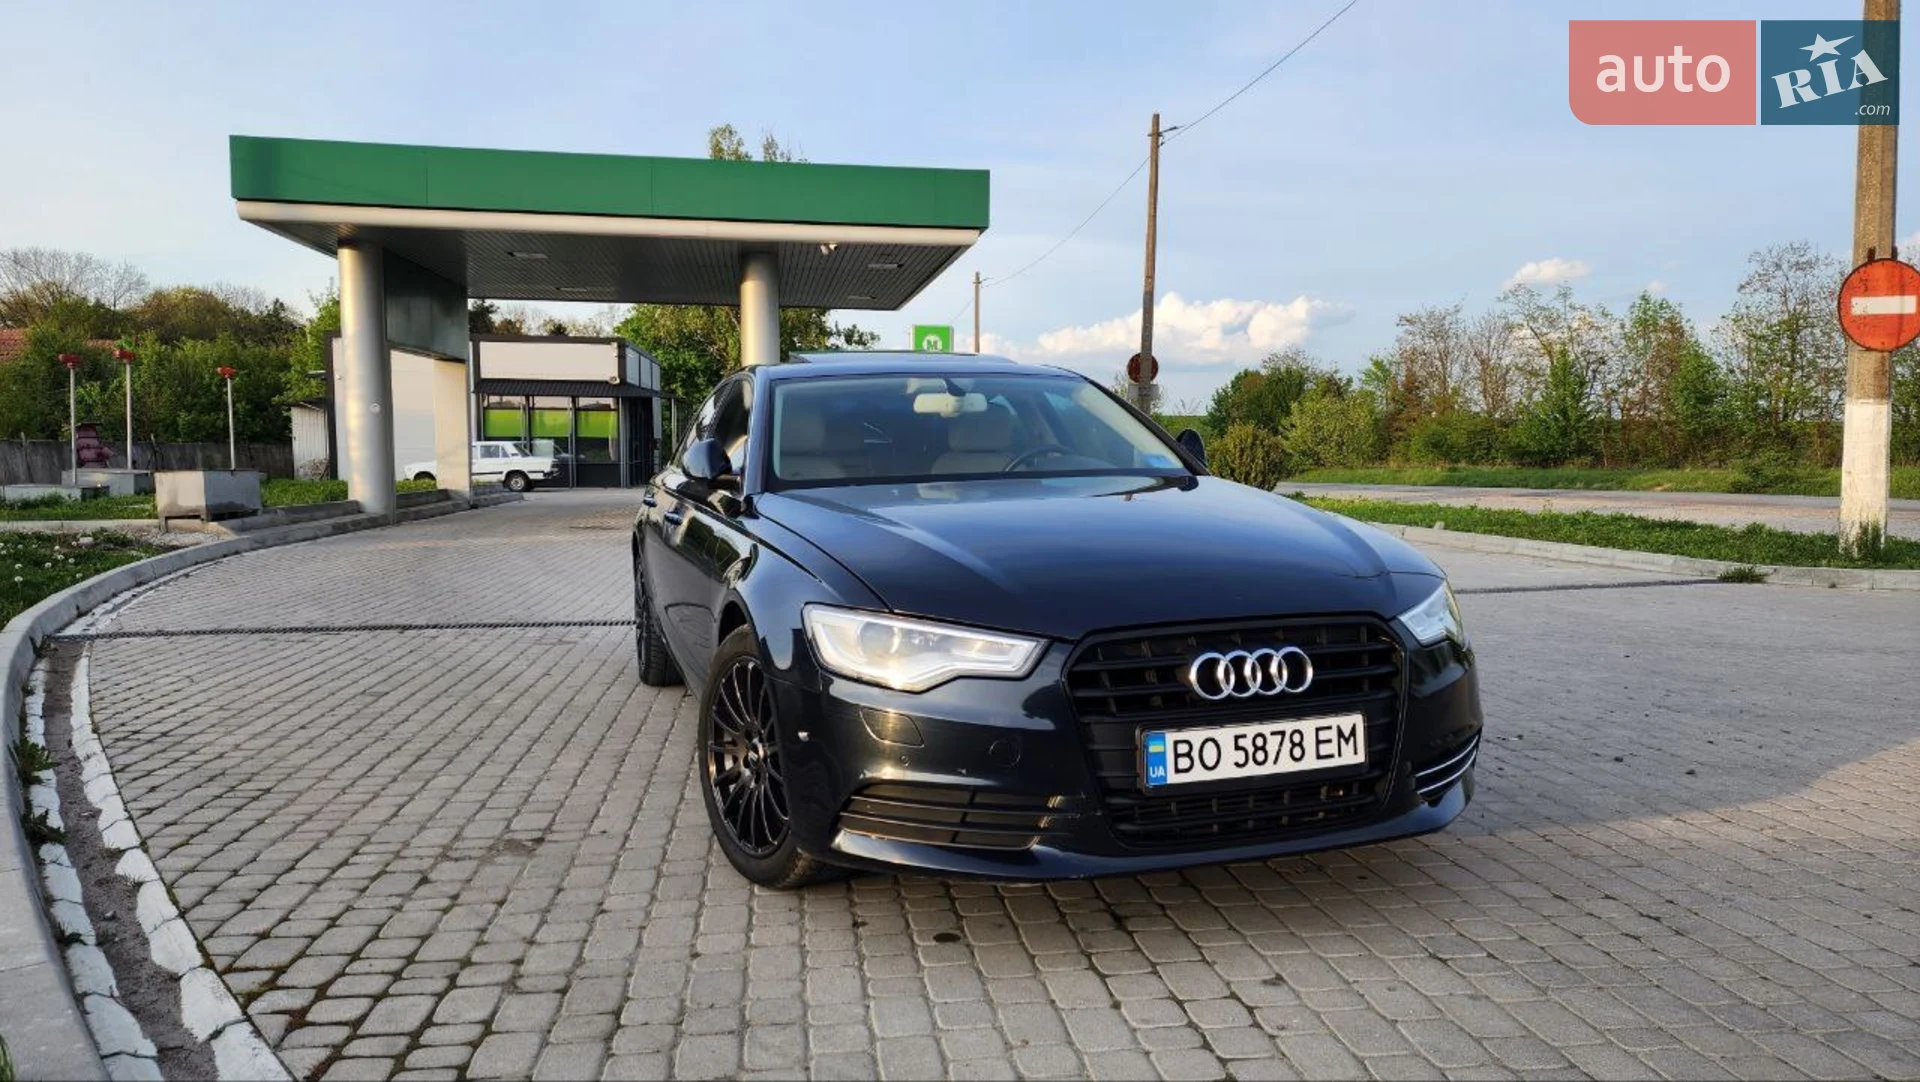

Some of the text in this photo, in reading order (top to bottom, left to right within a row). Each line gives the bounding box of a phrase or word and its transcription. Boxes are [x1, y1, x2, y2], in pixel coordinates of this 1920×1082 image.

[1172, 723, 1359, 775] BO 5878 EM
[1150, 766, 1166, 778] UA
